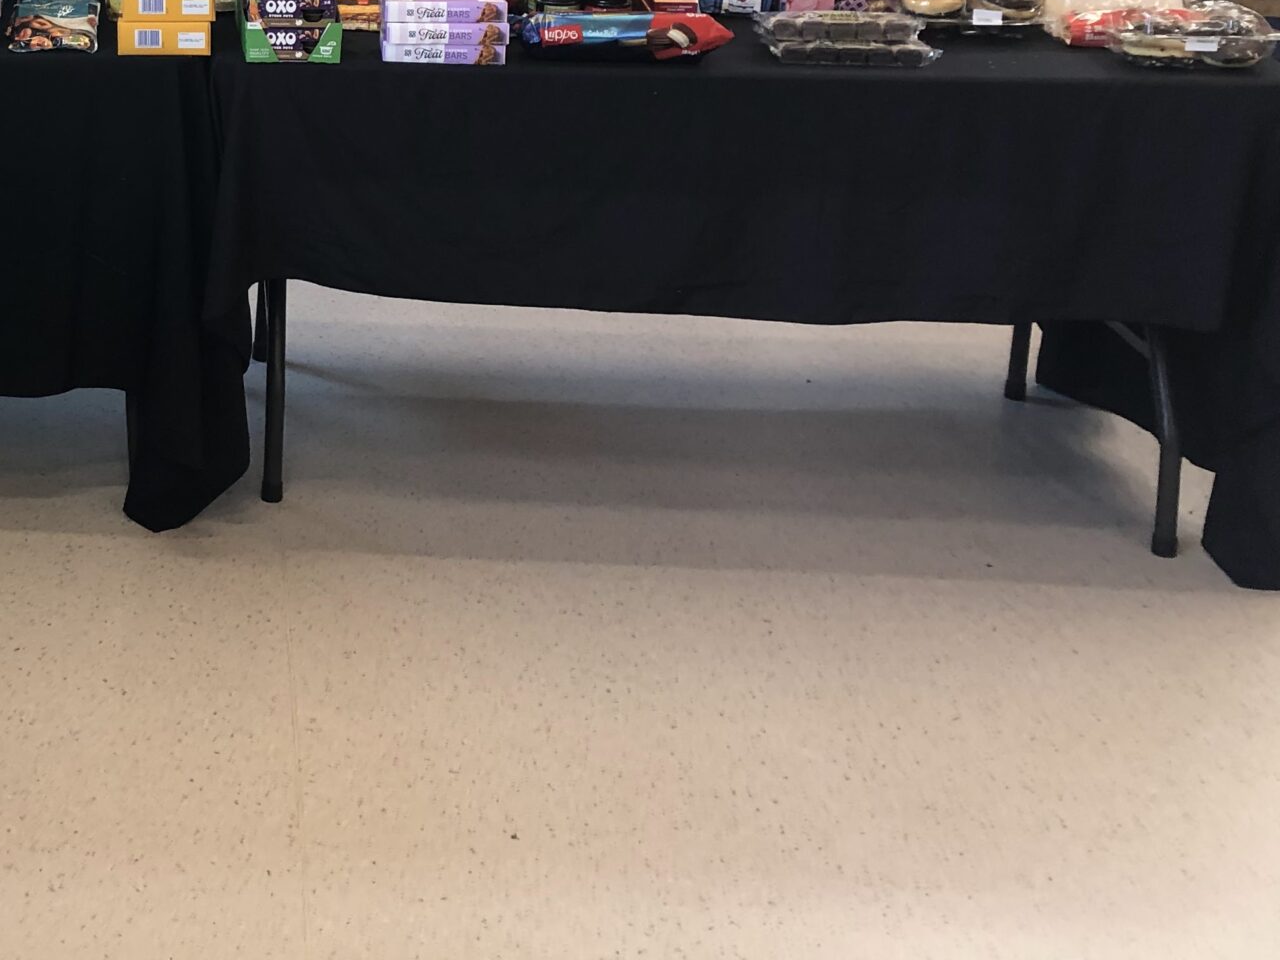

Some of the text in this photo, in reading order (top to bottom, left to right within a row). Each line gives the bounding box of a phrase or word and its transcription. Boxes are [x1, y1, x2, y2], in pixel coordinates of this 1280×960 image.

[265, 0, 297, 14] OXO
[416, 7, 471, 19] Treat BARS
[266, 32, 296, 46] OXO
[418, 28, 473, 41] Treat BARS
[544, 29, 579, 44] Luppo
[414, 47, 468, 60] Treat BARS
